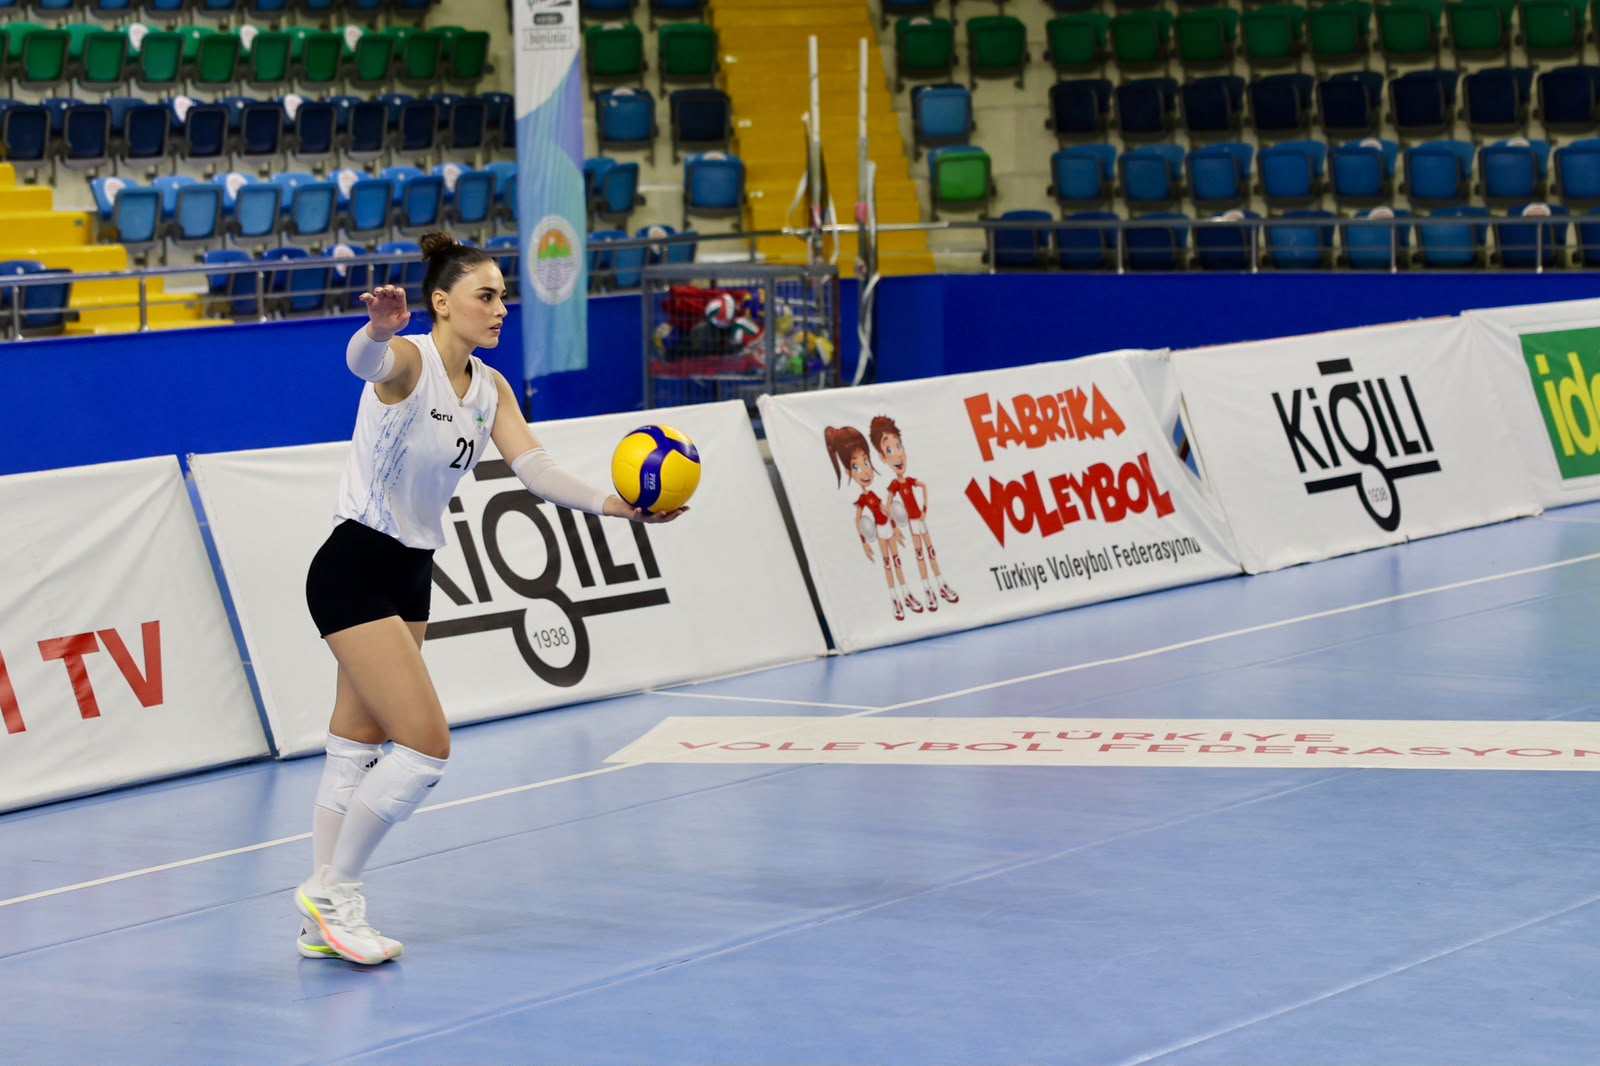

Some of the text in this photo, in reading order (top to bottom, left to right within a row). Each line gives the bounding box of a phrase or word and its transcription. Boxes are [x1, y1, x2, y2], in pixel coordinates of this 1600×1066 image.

[1535, 352, 1600, 456] id
[449, 437, 474, 470] 21
[965, 452, 1175, 549] VOLEYBOL
[990, 536, 1201, 591] Türkiye Voleybol Federasyonu
[533, 626, 570, 648] 1938
[37, 620, 163, 720] TV
[678, 741, 1064, 752] VOLEYBOL
[1011, 730, 1335, 742] TÜRKİYE
